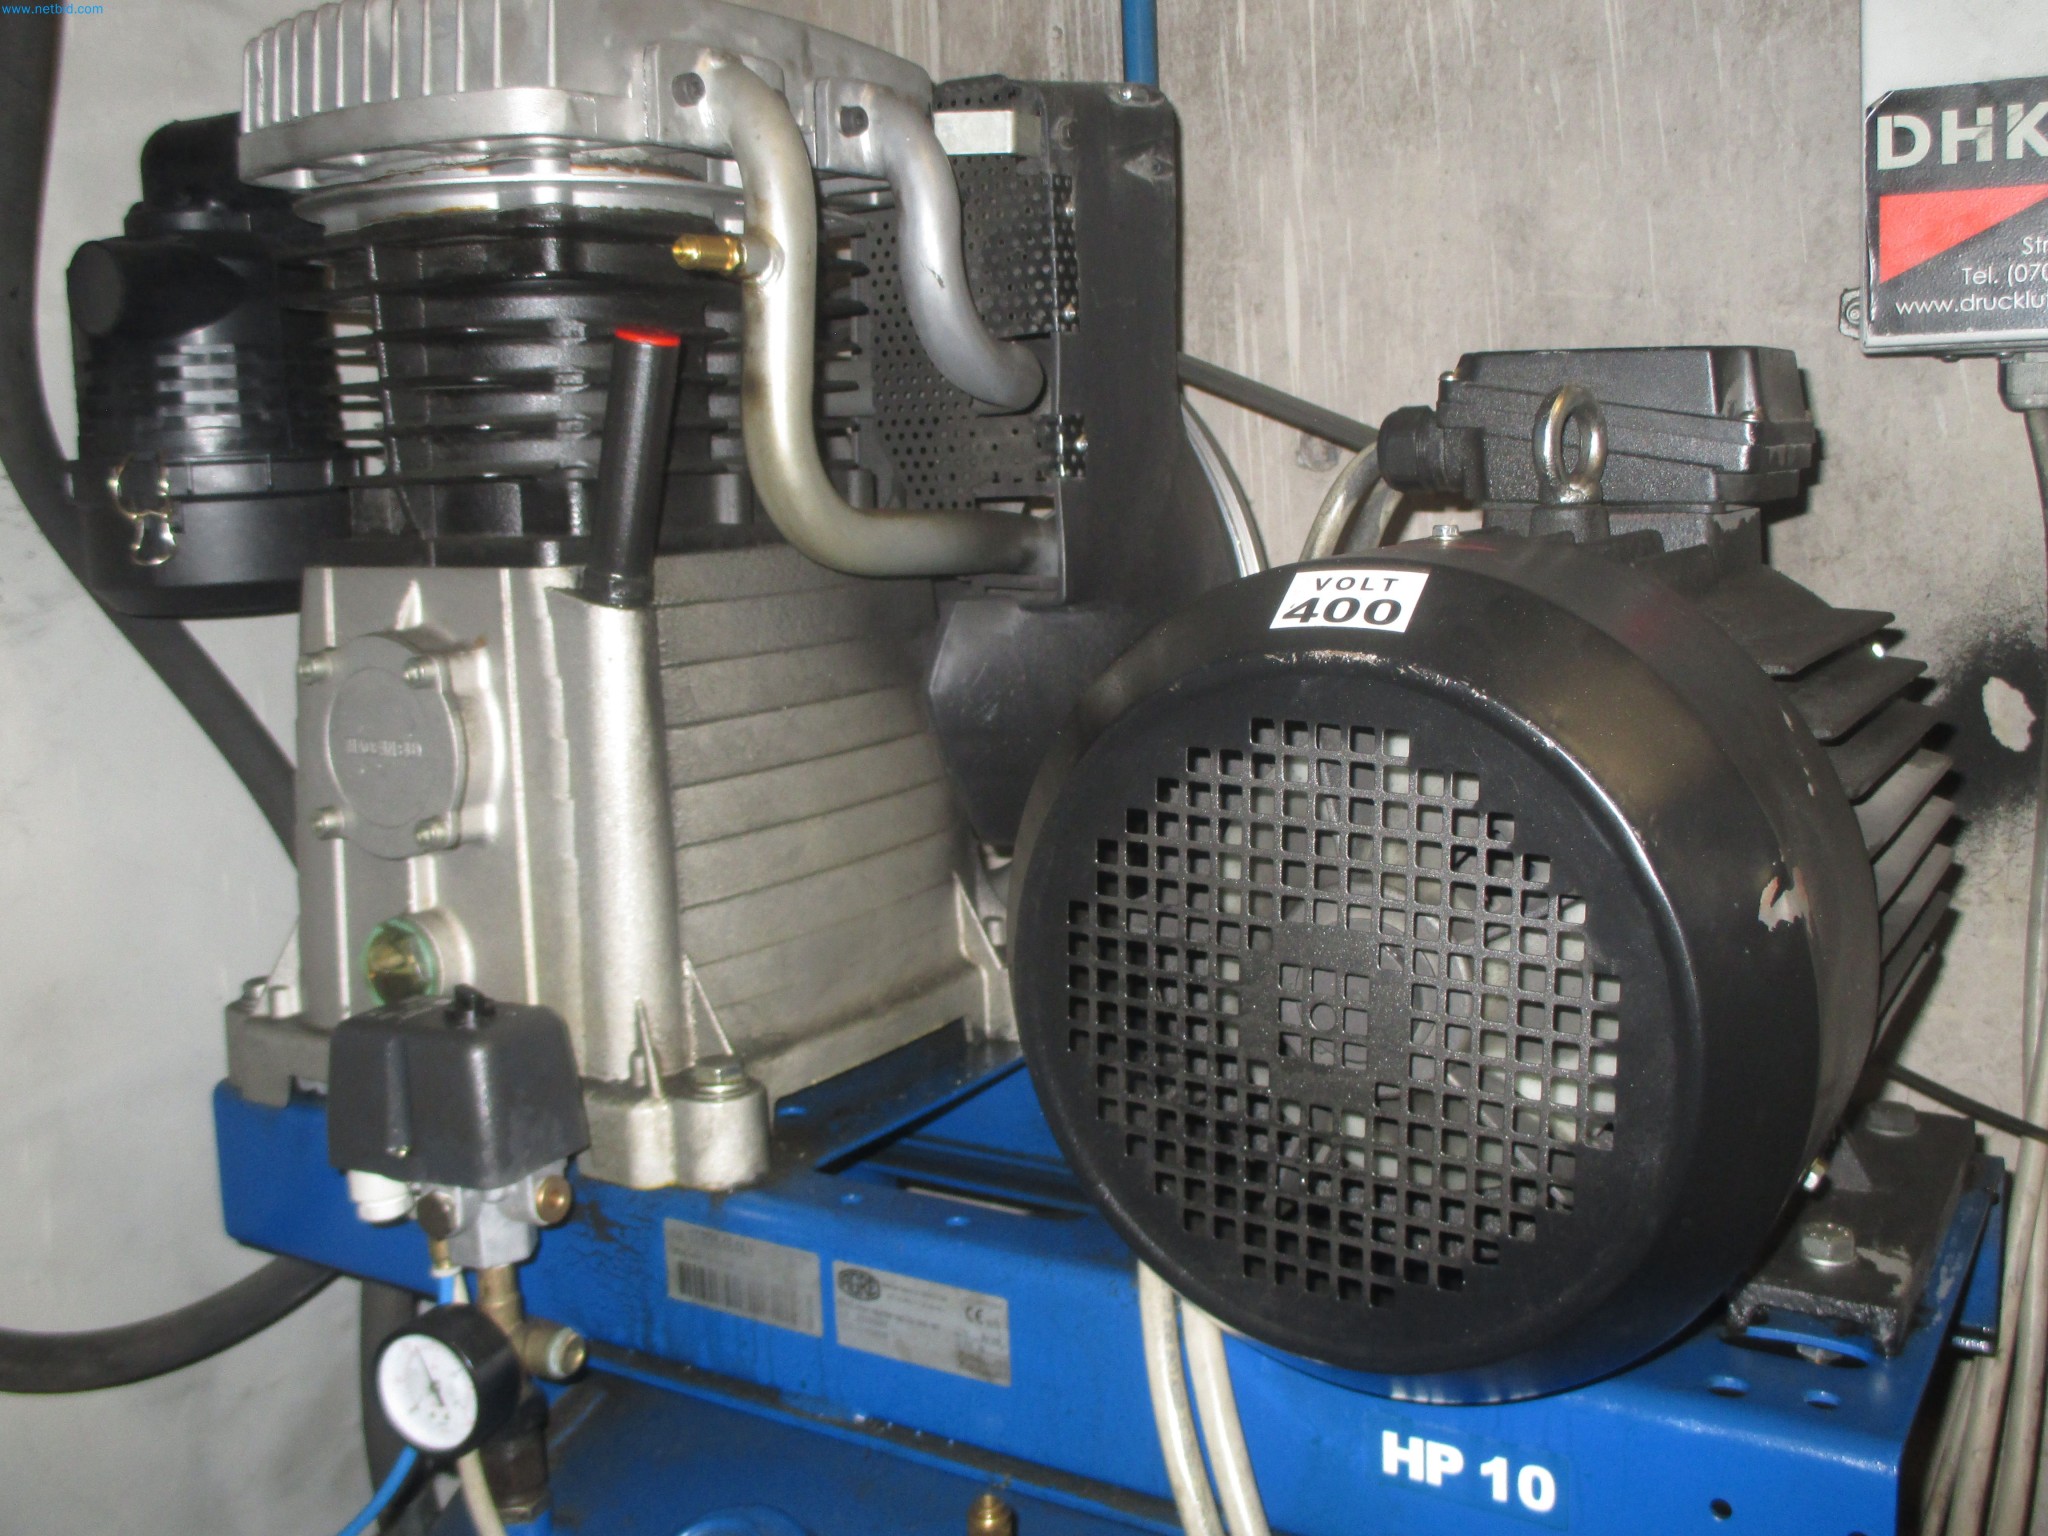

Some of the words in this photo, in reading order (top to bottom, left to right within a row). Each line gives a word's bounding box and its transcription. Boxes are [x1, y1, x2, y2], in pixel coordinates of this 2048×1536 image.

[1876, 101, 2048, 170] DHK
[1961, 266, 1999, 286] Tel.
[1315, 577, 1399, 591] VOLT
[1282, 597, 1402, 626] 400
[1382, 1429, 1464, 1487] HP
[1480, 1455, 1556, 1513] 10
